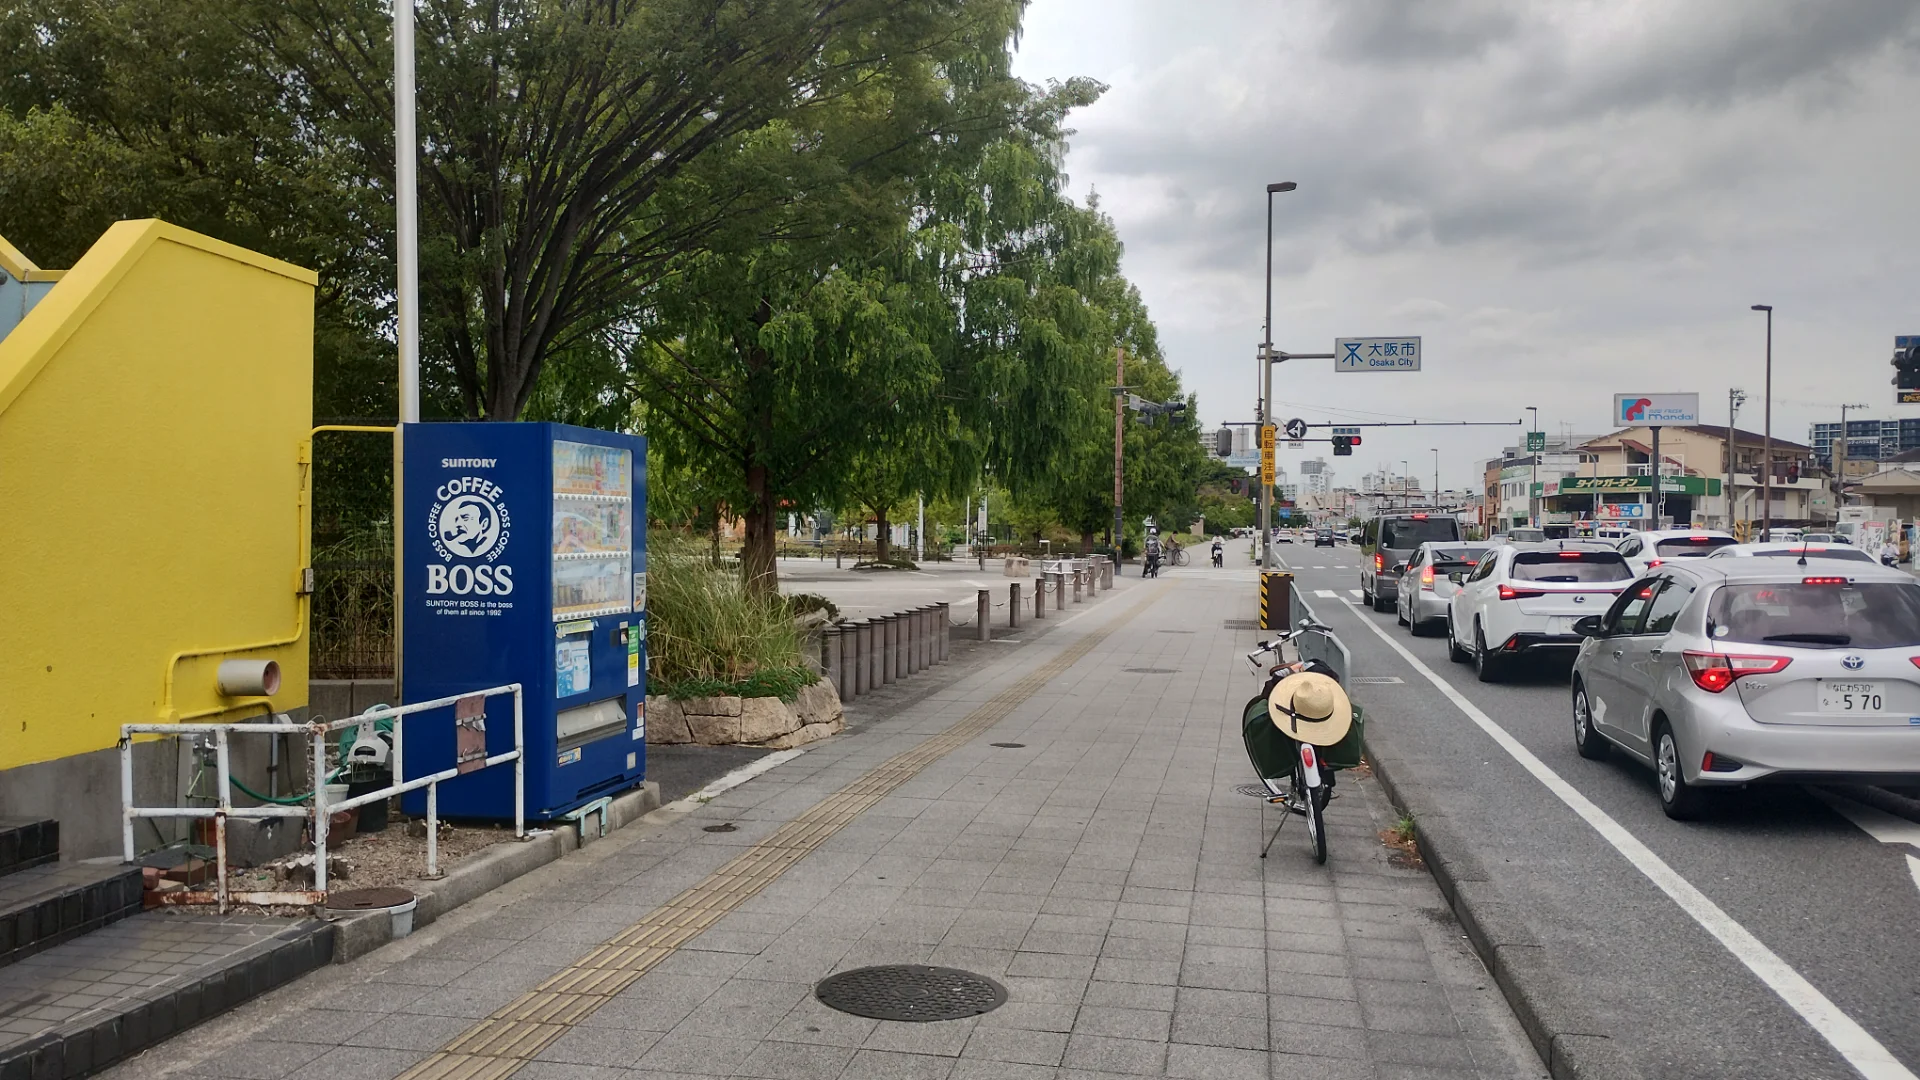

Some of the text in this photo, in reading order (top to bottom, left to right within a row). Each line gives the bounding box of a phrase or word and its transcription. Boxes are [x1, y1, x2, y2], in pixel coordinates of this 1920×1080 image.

[1367, 342, 1416, 357] 大阪市
[1369, 357, 1414, 368] Osaka City
[441, 458, 498, 468] SUNTORY
[1263, 429, 1274, 481] 自転車注意
[436, 476, 504, 503] COFFEE
[428, 502, 453, 562] BOSS COFFEE
[486, 503, 511, 562] BOSS COFFEE
[426, 564, 514, 596] BOSS
[460, 600, 479, 608] BOSS
[480, 600, 486, 608] is
